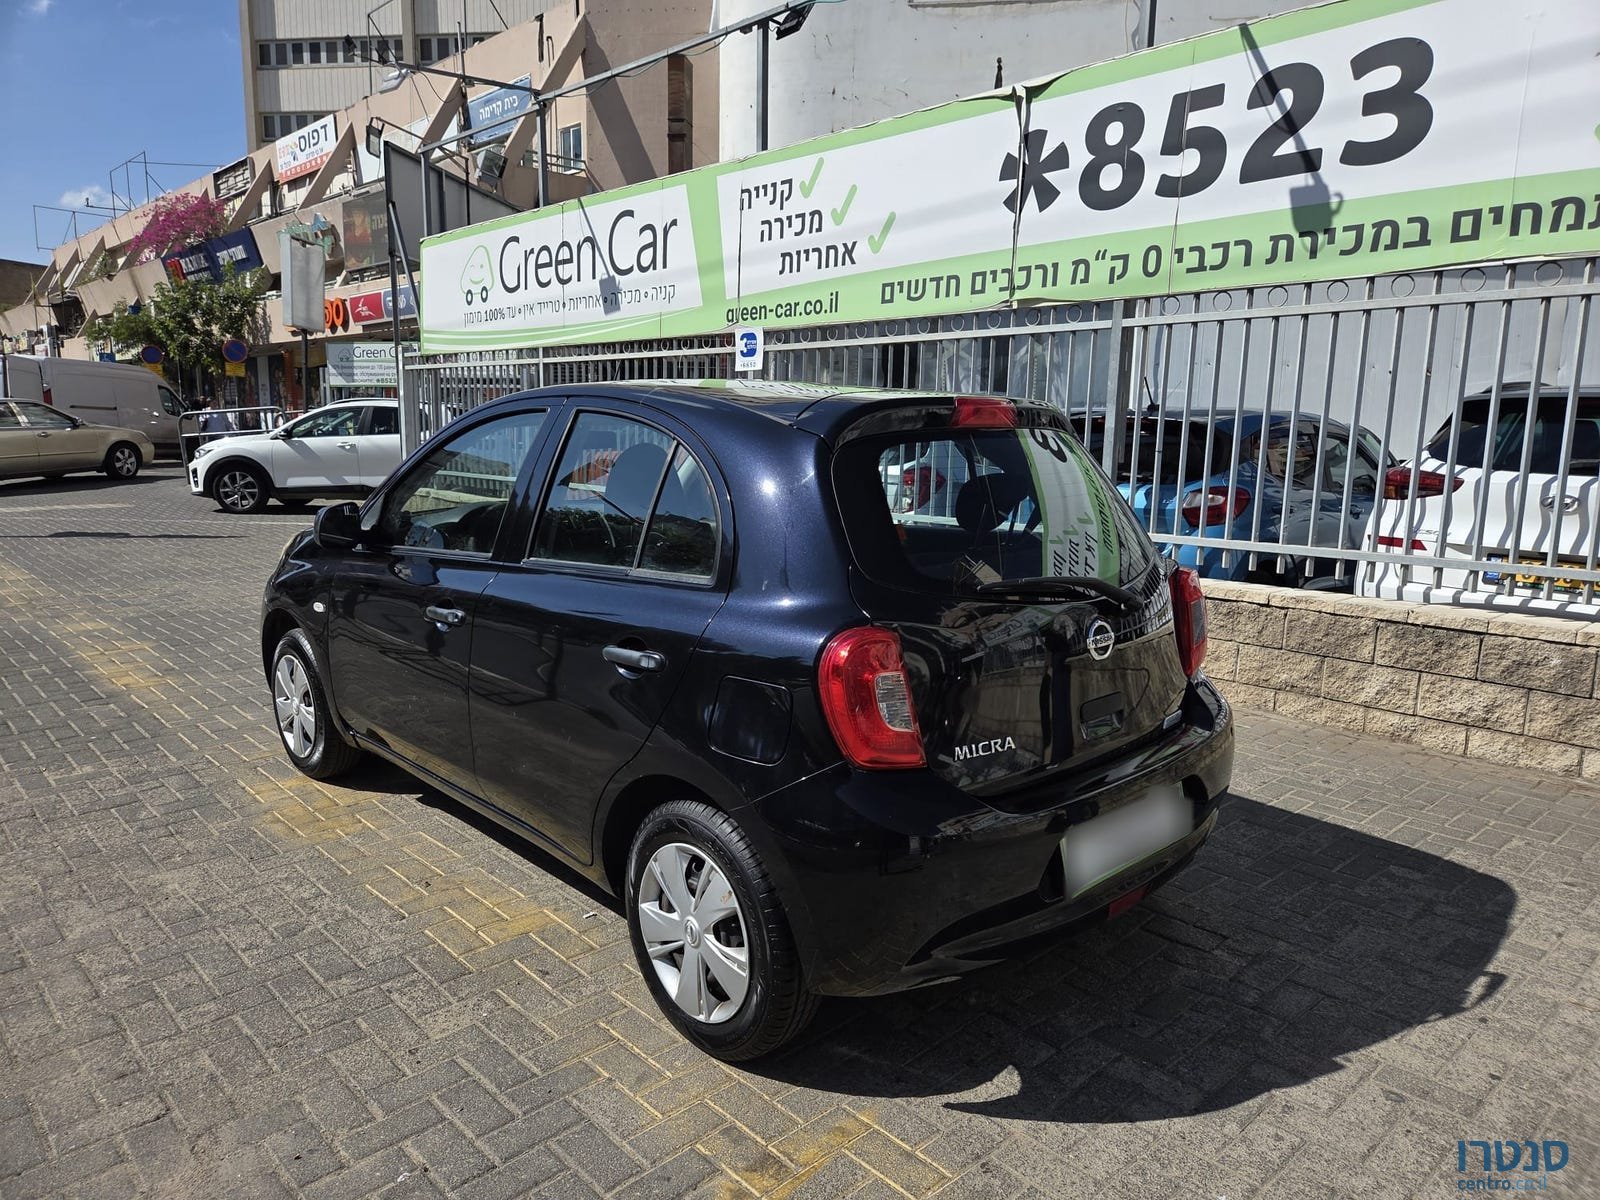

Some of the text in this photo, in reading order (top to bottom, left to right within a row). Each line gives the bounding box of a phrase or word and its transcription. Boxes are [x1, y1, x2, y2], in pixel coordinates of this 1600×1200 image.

[298, 123, 328, 152] דפוס
[740, 178, 793, 211] קנייה
[760, 209, 823, 242] מכירה
[1264, 216, 1432, 264] במכירת
[499, 209, 678, 293] Green Car
[778, 241, 858, 275] אחריות
[1142, 244, 1163, 278] 0
[1173, 238, 1254, 274] רכבי
[881, 274, 961, 304] חדשים
[970, 262, 1059, 296] ורכבים
[537, 300, 561, 314] טרייד
[568, 294, 602, 311] אחריות
[610, 289, 641, 307] מכירה
[651, 284, 676, 304] קניה
[484, 307, 506, 322] 100%
[506, 306, 517, 319] עד
[523, 303, 535, 320] אין
[352, 346, 386, 358] Green
[954, 736, 1016, 761] MICRA
